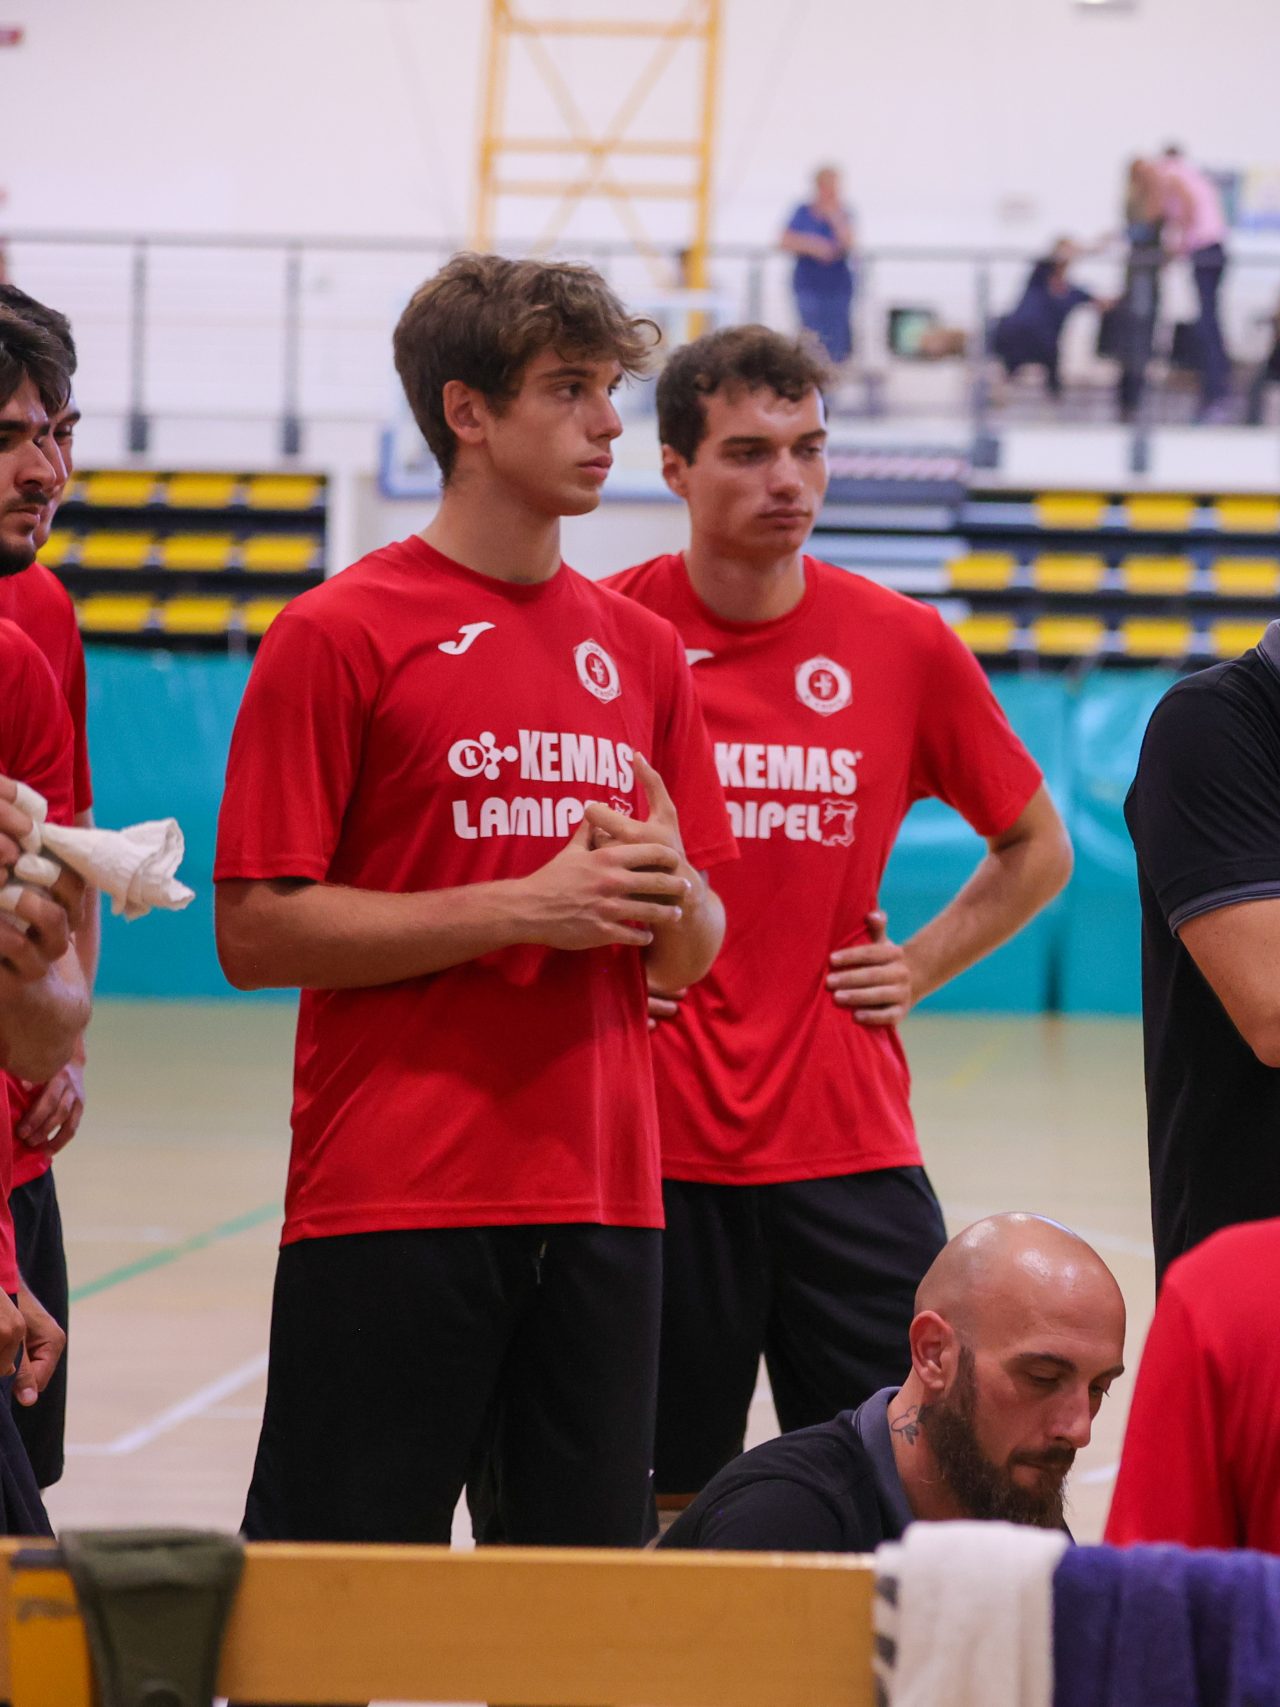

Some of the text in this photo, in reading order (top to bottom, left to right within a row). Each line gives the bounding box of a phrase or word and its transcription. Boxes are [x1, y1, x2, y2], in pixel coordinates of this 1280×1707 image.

[518, 729, 635, 793] KEMAS
[714, 742, 858, 796] KEMAS
[452, 796, 609, 839] LAMIP
